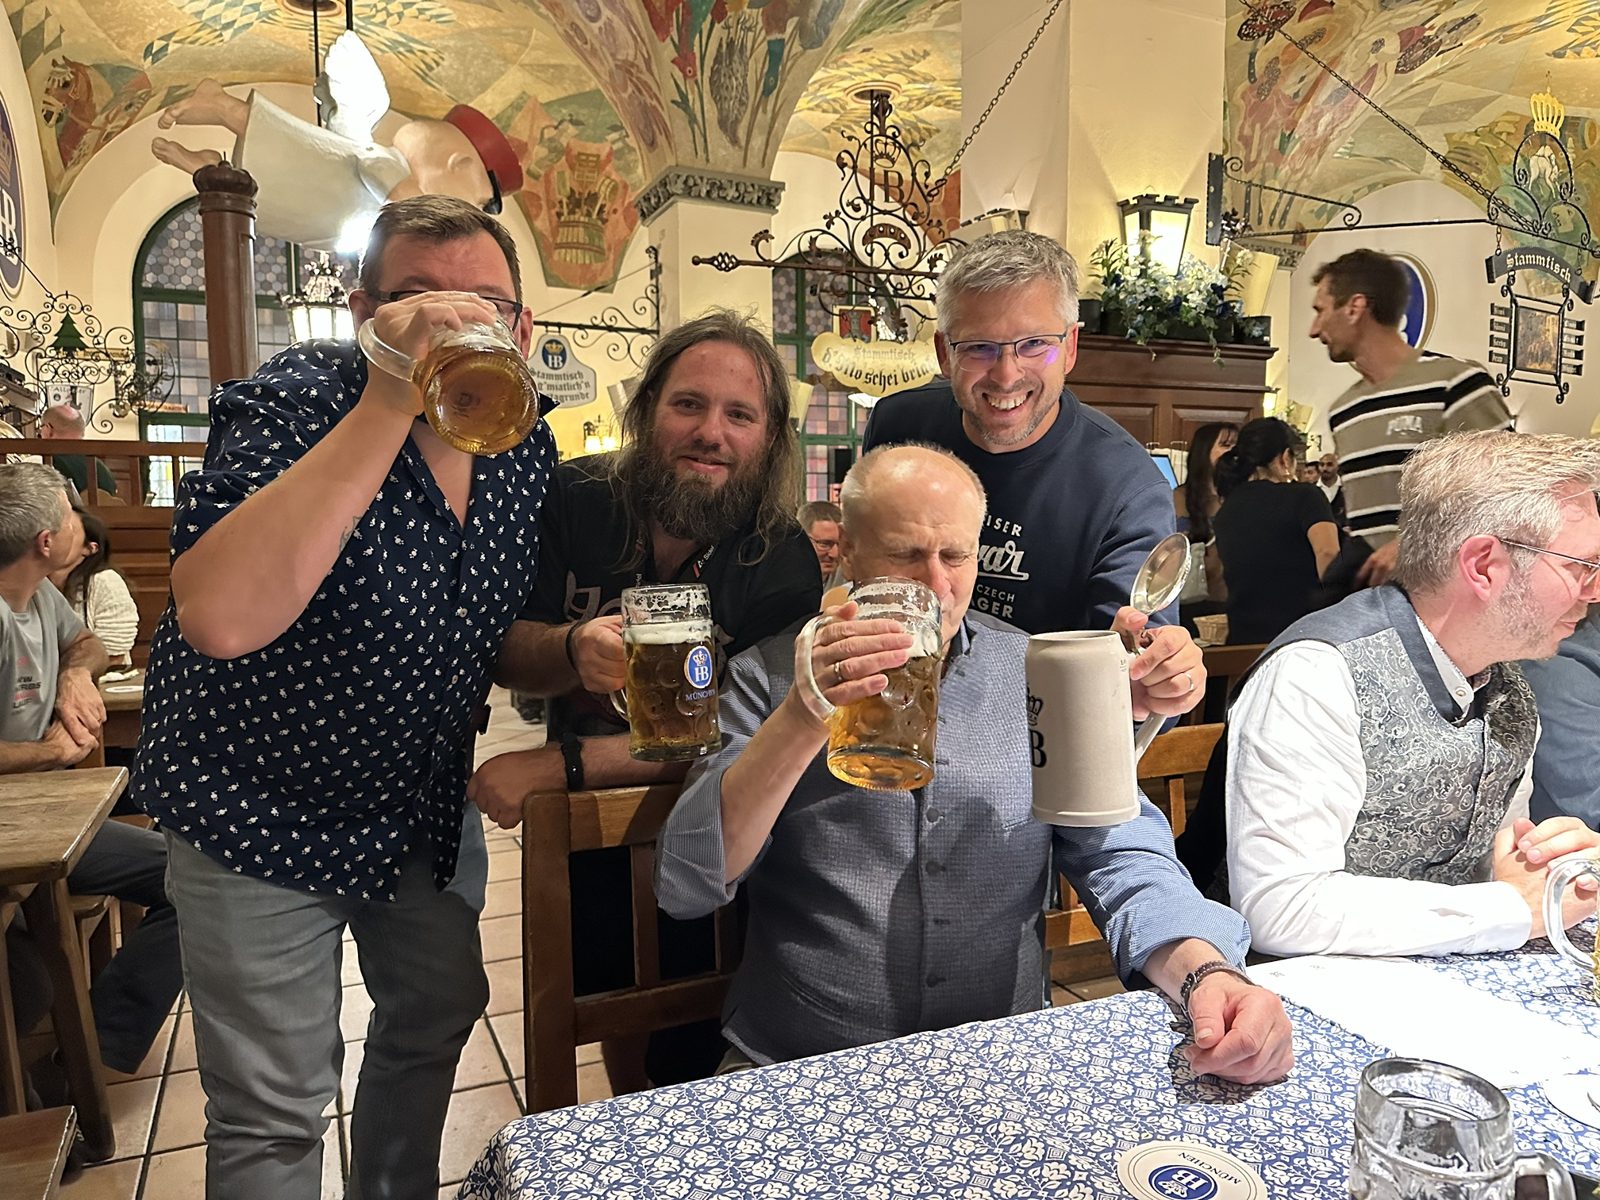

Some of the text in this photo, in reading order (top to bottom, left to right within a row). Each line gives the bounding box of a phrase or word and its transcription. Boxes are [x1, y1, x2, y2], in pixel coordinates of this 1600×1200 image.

[869, 167, 905, 204] HB
[1506, 252, 1572, 284] Stammtisch
[547, 354, 564, 369] HB
[529, 367, 585, 381] Stammtisch
[985, 514, 1023, 537] ISER
[976, 584, 1016, 603] CZECH
[972, 597, 1014, 619] GER
[694, 665, 709, 682] HB
[1177, 1151, 1243, 1185] MÜNCHEN
[1171, 1169, 1210, 1191] HB
